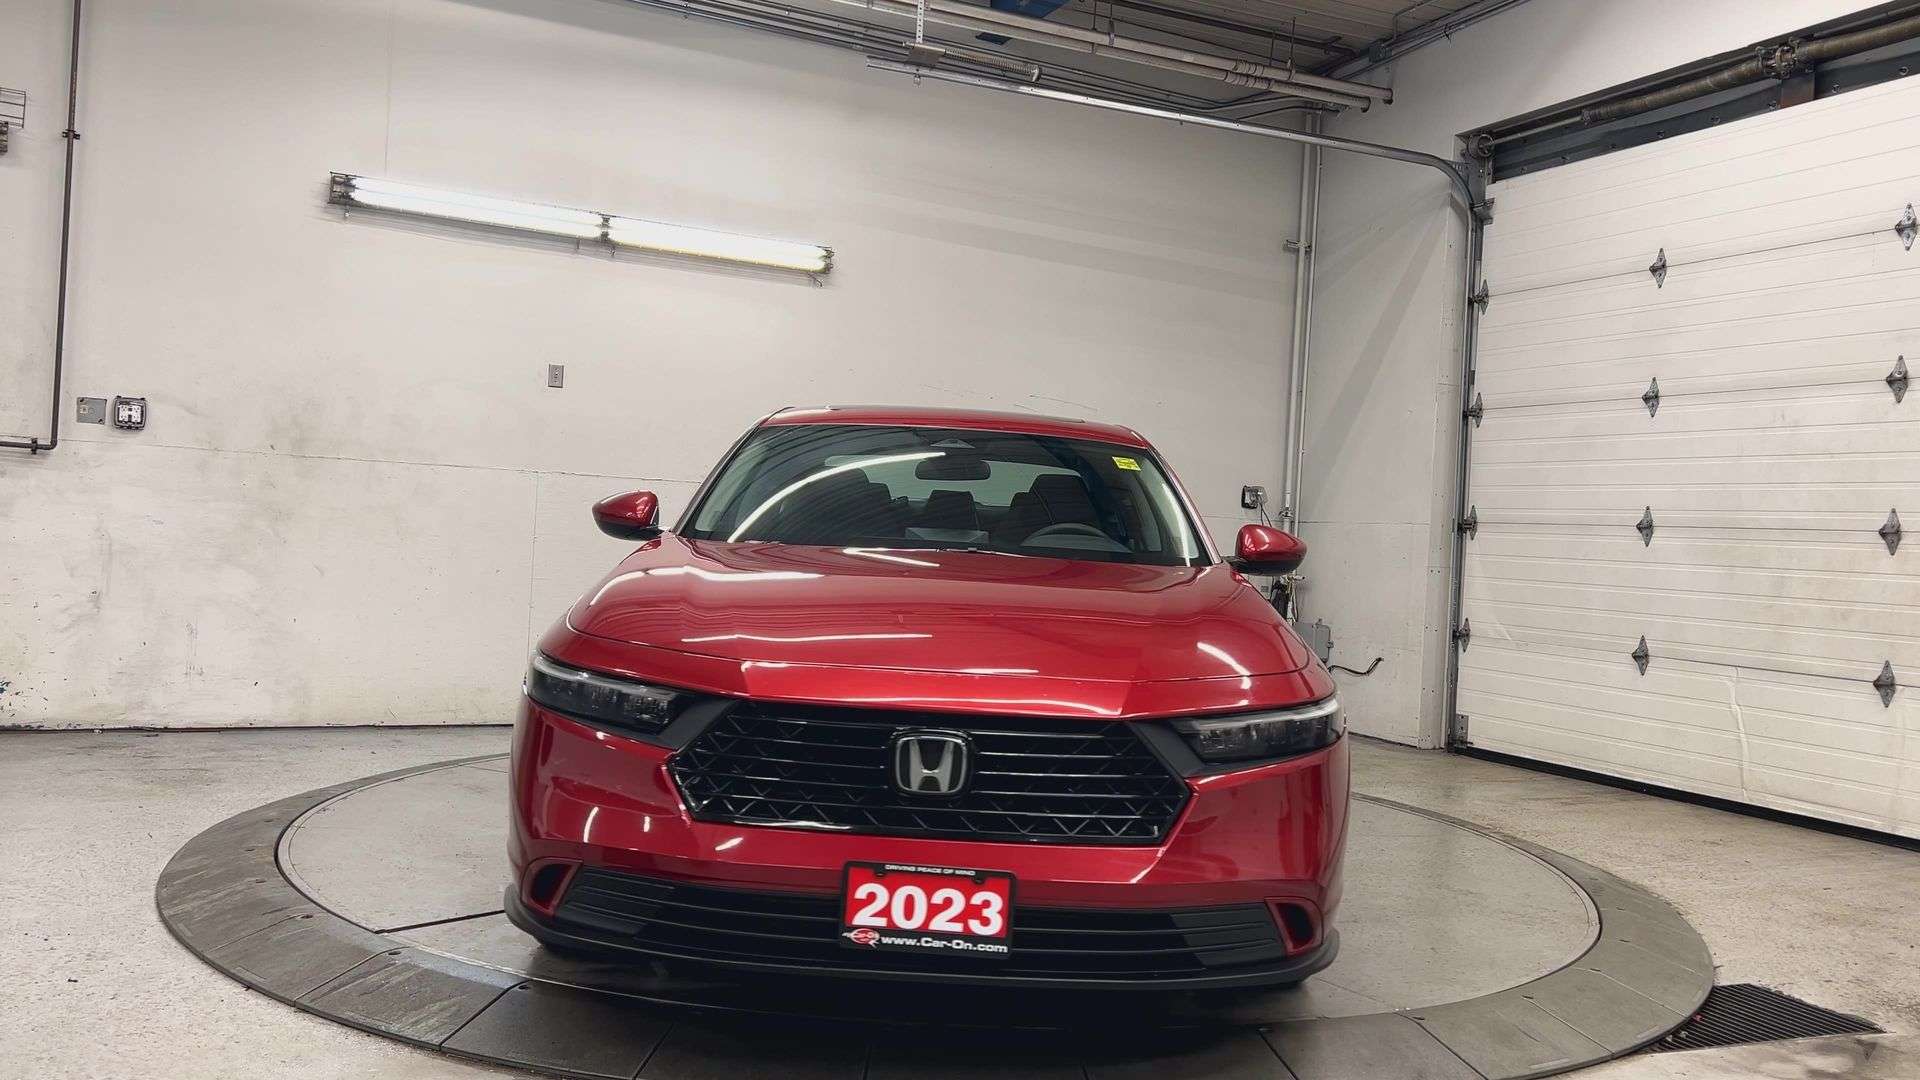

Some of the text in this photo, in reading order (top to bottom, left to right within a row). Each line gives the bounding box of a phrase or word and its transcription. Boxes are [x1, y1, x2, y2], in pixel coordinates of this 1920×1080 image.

[884, 864, 916, 872] DRIVING
[916, 866, 942, 874] PEACE
[851, 882, 1004, 936] 2023
[881, 936, 1009, 954] www.Car-On.com
